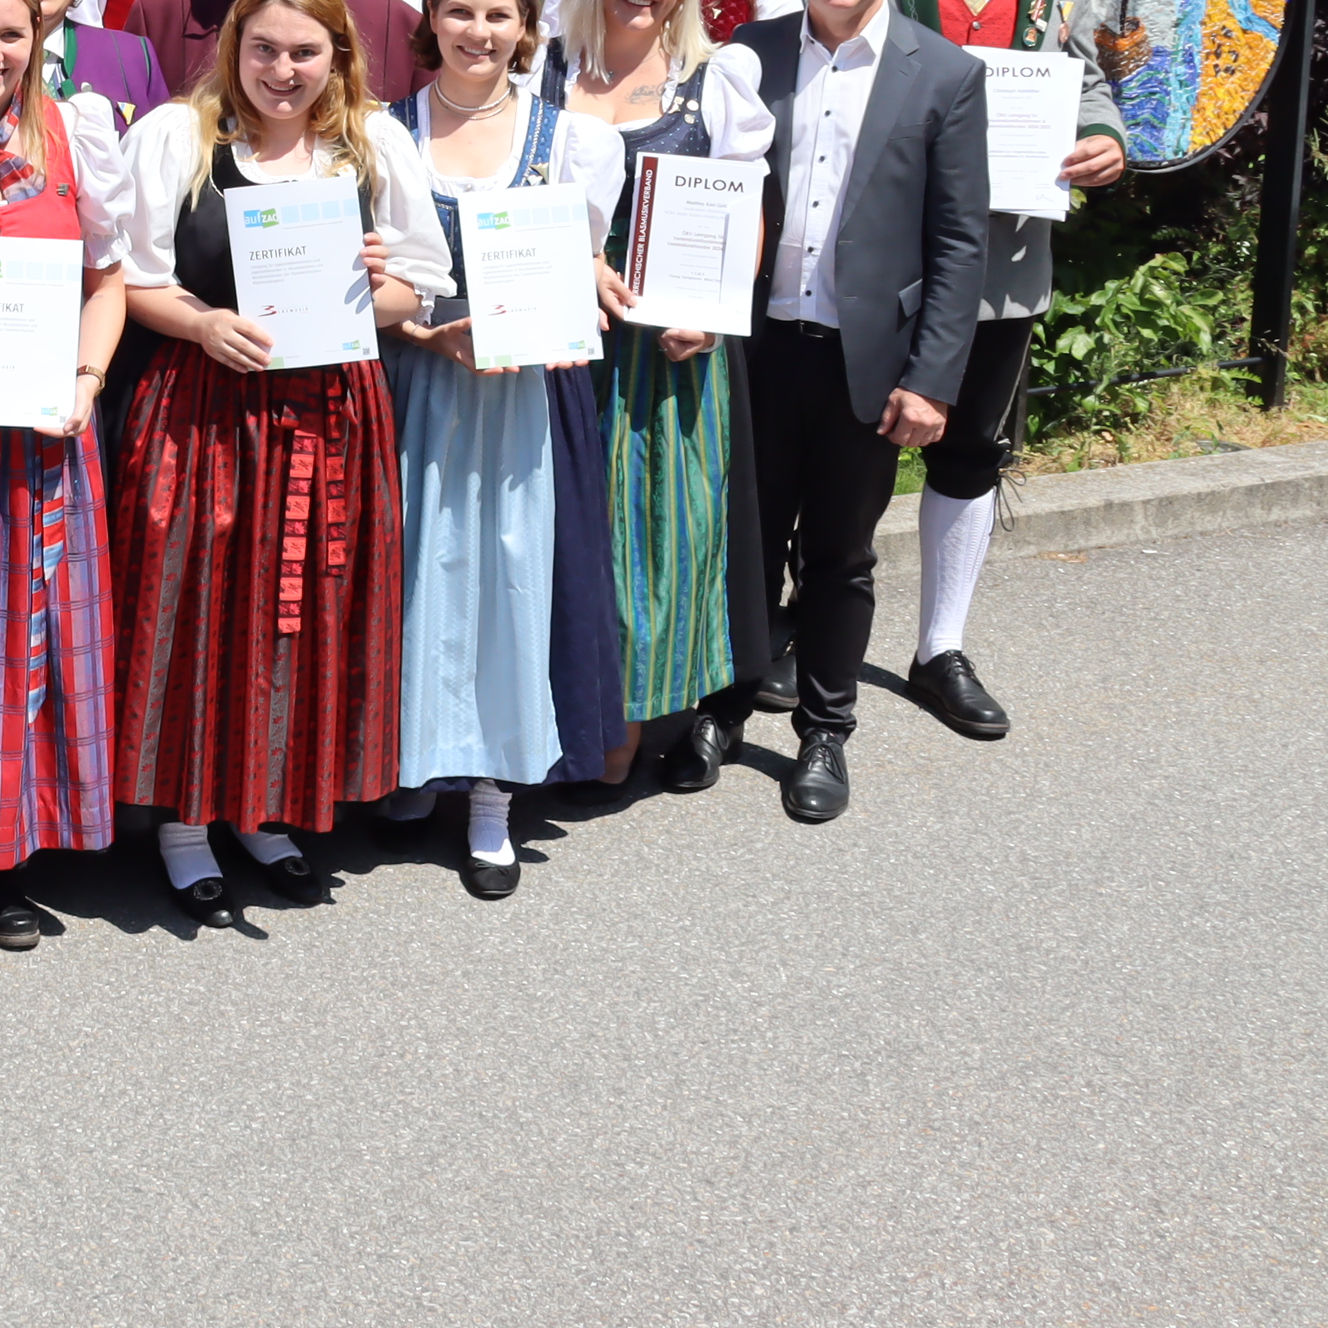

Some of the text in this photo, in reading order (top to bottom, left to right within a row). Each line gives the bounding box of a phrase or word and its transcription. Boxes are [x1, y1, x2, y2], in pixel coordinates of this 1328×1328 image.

[985, 67, 1051, 78] DIPLOM
[675, 175, 744, 193] DIPLOM
[639, 169, 653, 242] BLASMUSIKVERBAND
[249, 246, 306, 261] ZERTIFIKAT
[481, 248, 536, 262] ZERTIFIKAT
